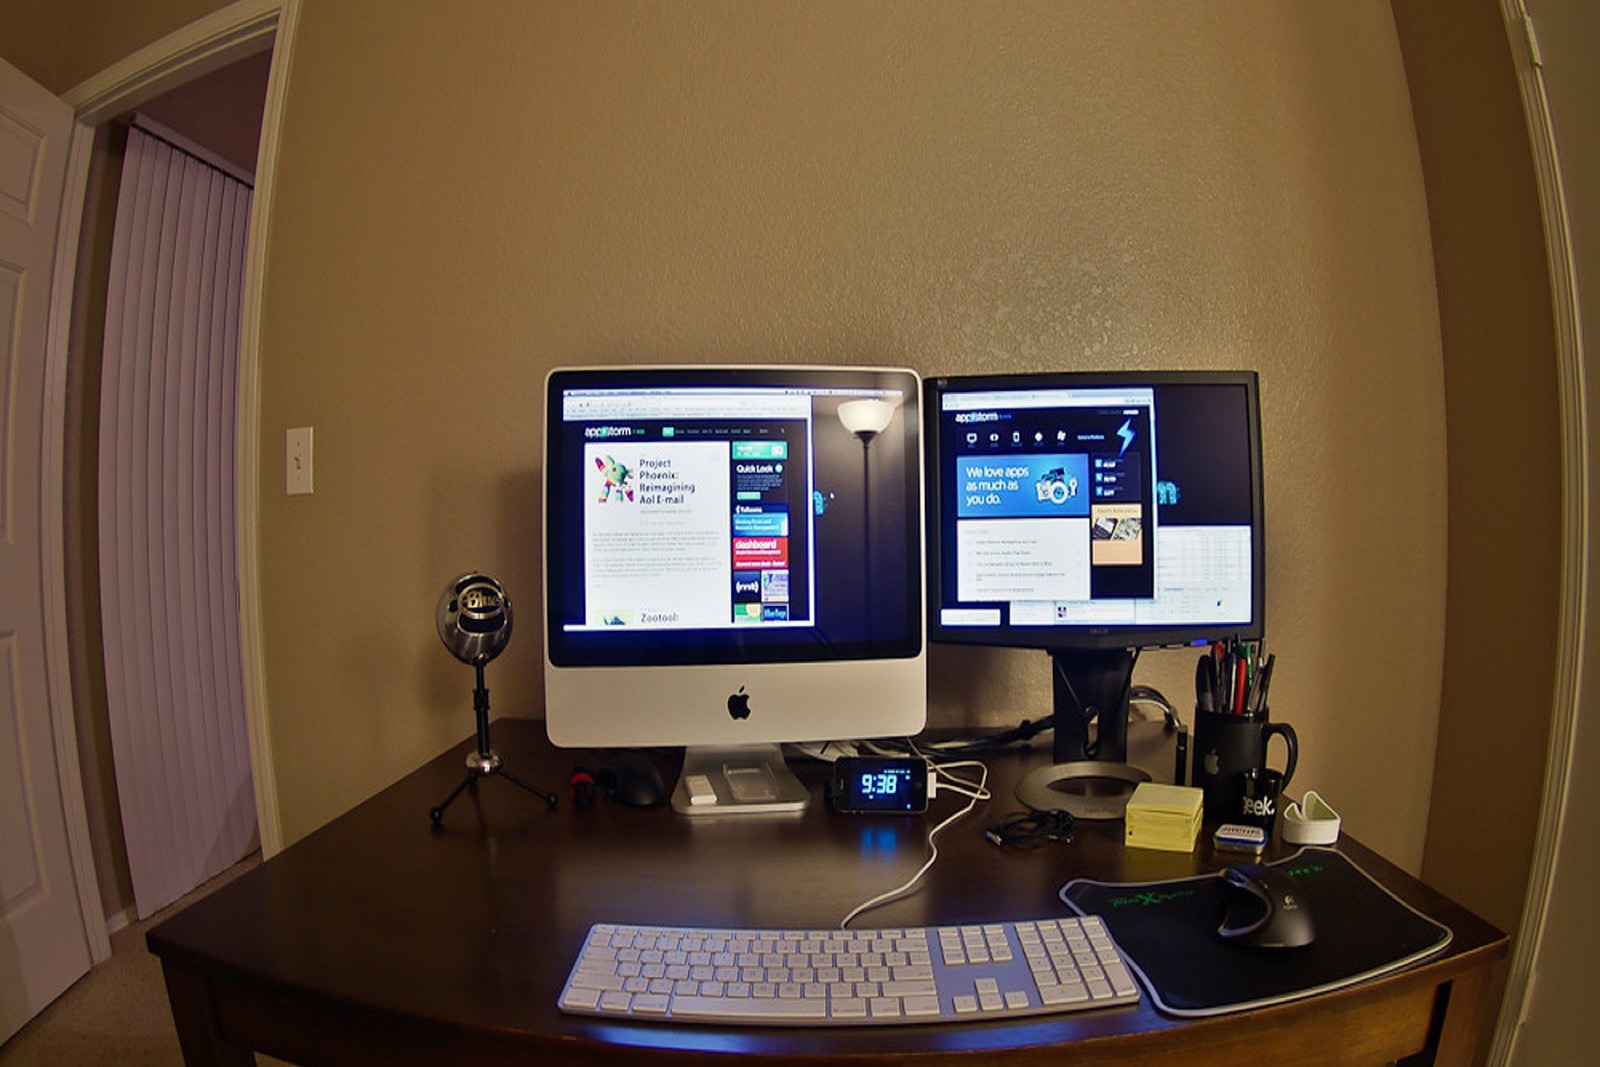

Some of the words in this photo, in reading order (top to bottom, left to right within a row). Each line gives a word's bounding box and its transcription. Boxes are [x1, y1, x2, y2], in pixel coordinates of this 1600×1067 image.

[639, 459, 671, 470] Project
[756, 464, 773, 473] Look
[639, 471, 679, 480] Phoenix:
[965, 466, 983, 478] We
[984, 465, 1004, 478] love
[1005, 466, 1029, 479] apps
[639, 483, 695, 493] Reimagining
[966, 481, 977, 491] as
[978, 479, 1006, 491] much
[1007, 480, 1019, 491] as
[639, 495, 655, 504] Aol
[656, 495, 684, 504] E-mail
[966, 495, 985, 507] you
[985, 493, 1002, 505] do.
[735, 539, 776, 549] dashboard
[641, 613, 679, 622] Zootool:
[862, 774, 897, 794] 9:38
